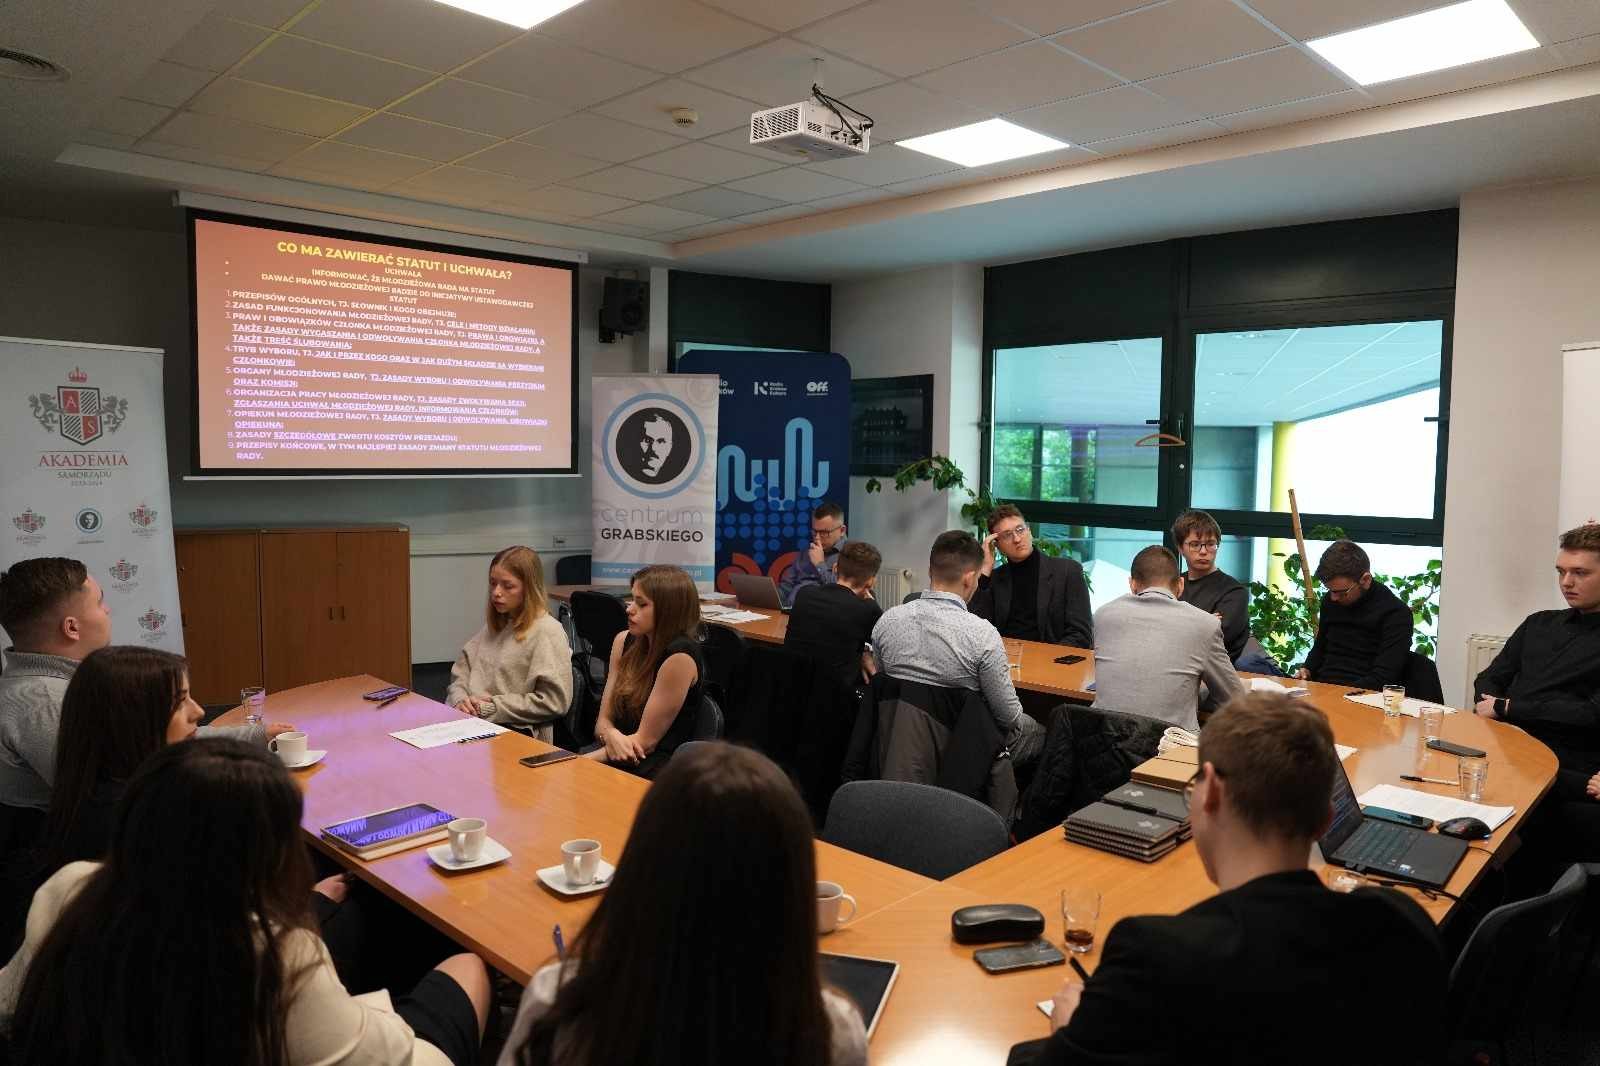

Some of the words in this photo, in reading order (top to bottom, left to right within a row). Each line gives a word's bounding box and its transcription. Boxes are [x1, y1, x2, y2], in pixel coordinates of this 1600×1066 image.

[278, 241, 297, 253] CO
[301, 245, 322, 256] MA
[326, 248, 394, 265] ZAWIERAĆ
[397, 256, 440, 270] STATUT
[443, 262, 447, 271] I
[450, 264, 512, 280] UCHWAŁA?
[385, 268, 422, 277] UCHWAŁA
[296, 278, 327, 287] PRAWO
[232, 302, 263, 310] ZASAD
[266, 304, 347, 318] FUNKCJONOWANIA
[351, 302, 387, 311] SŁOWNIK
[232, 313, 261, 321] PRAW
[65, 396, 77, 408] A
[87, 420, 96, 434] S
[39, 454, 129, 467] AKADEMIA
[601, 506, 704, 524] centrum
[601, 528, 704, 543] GRABSKIEGO
